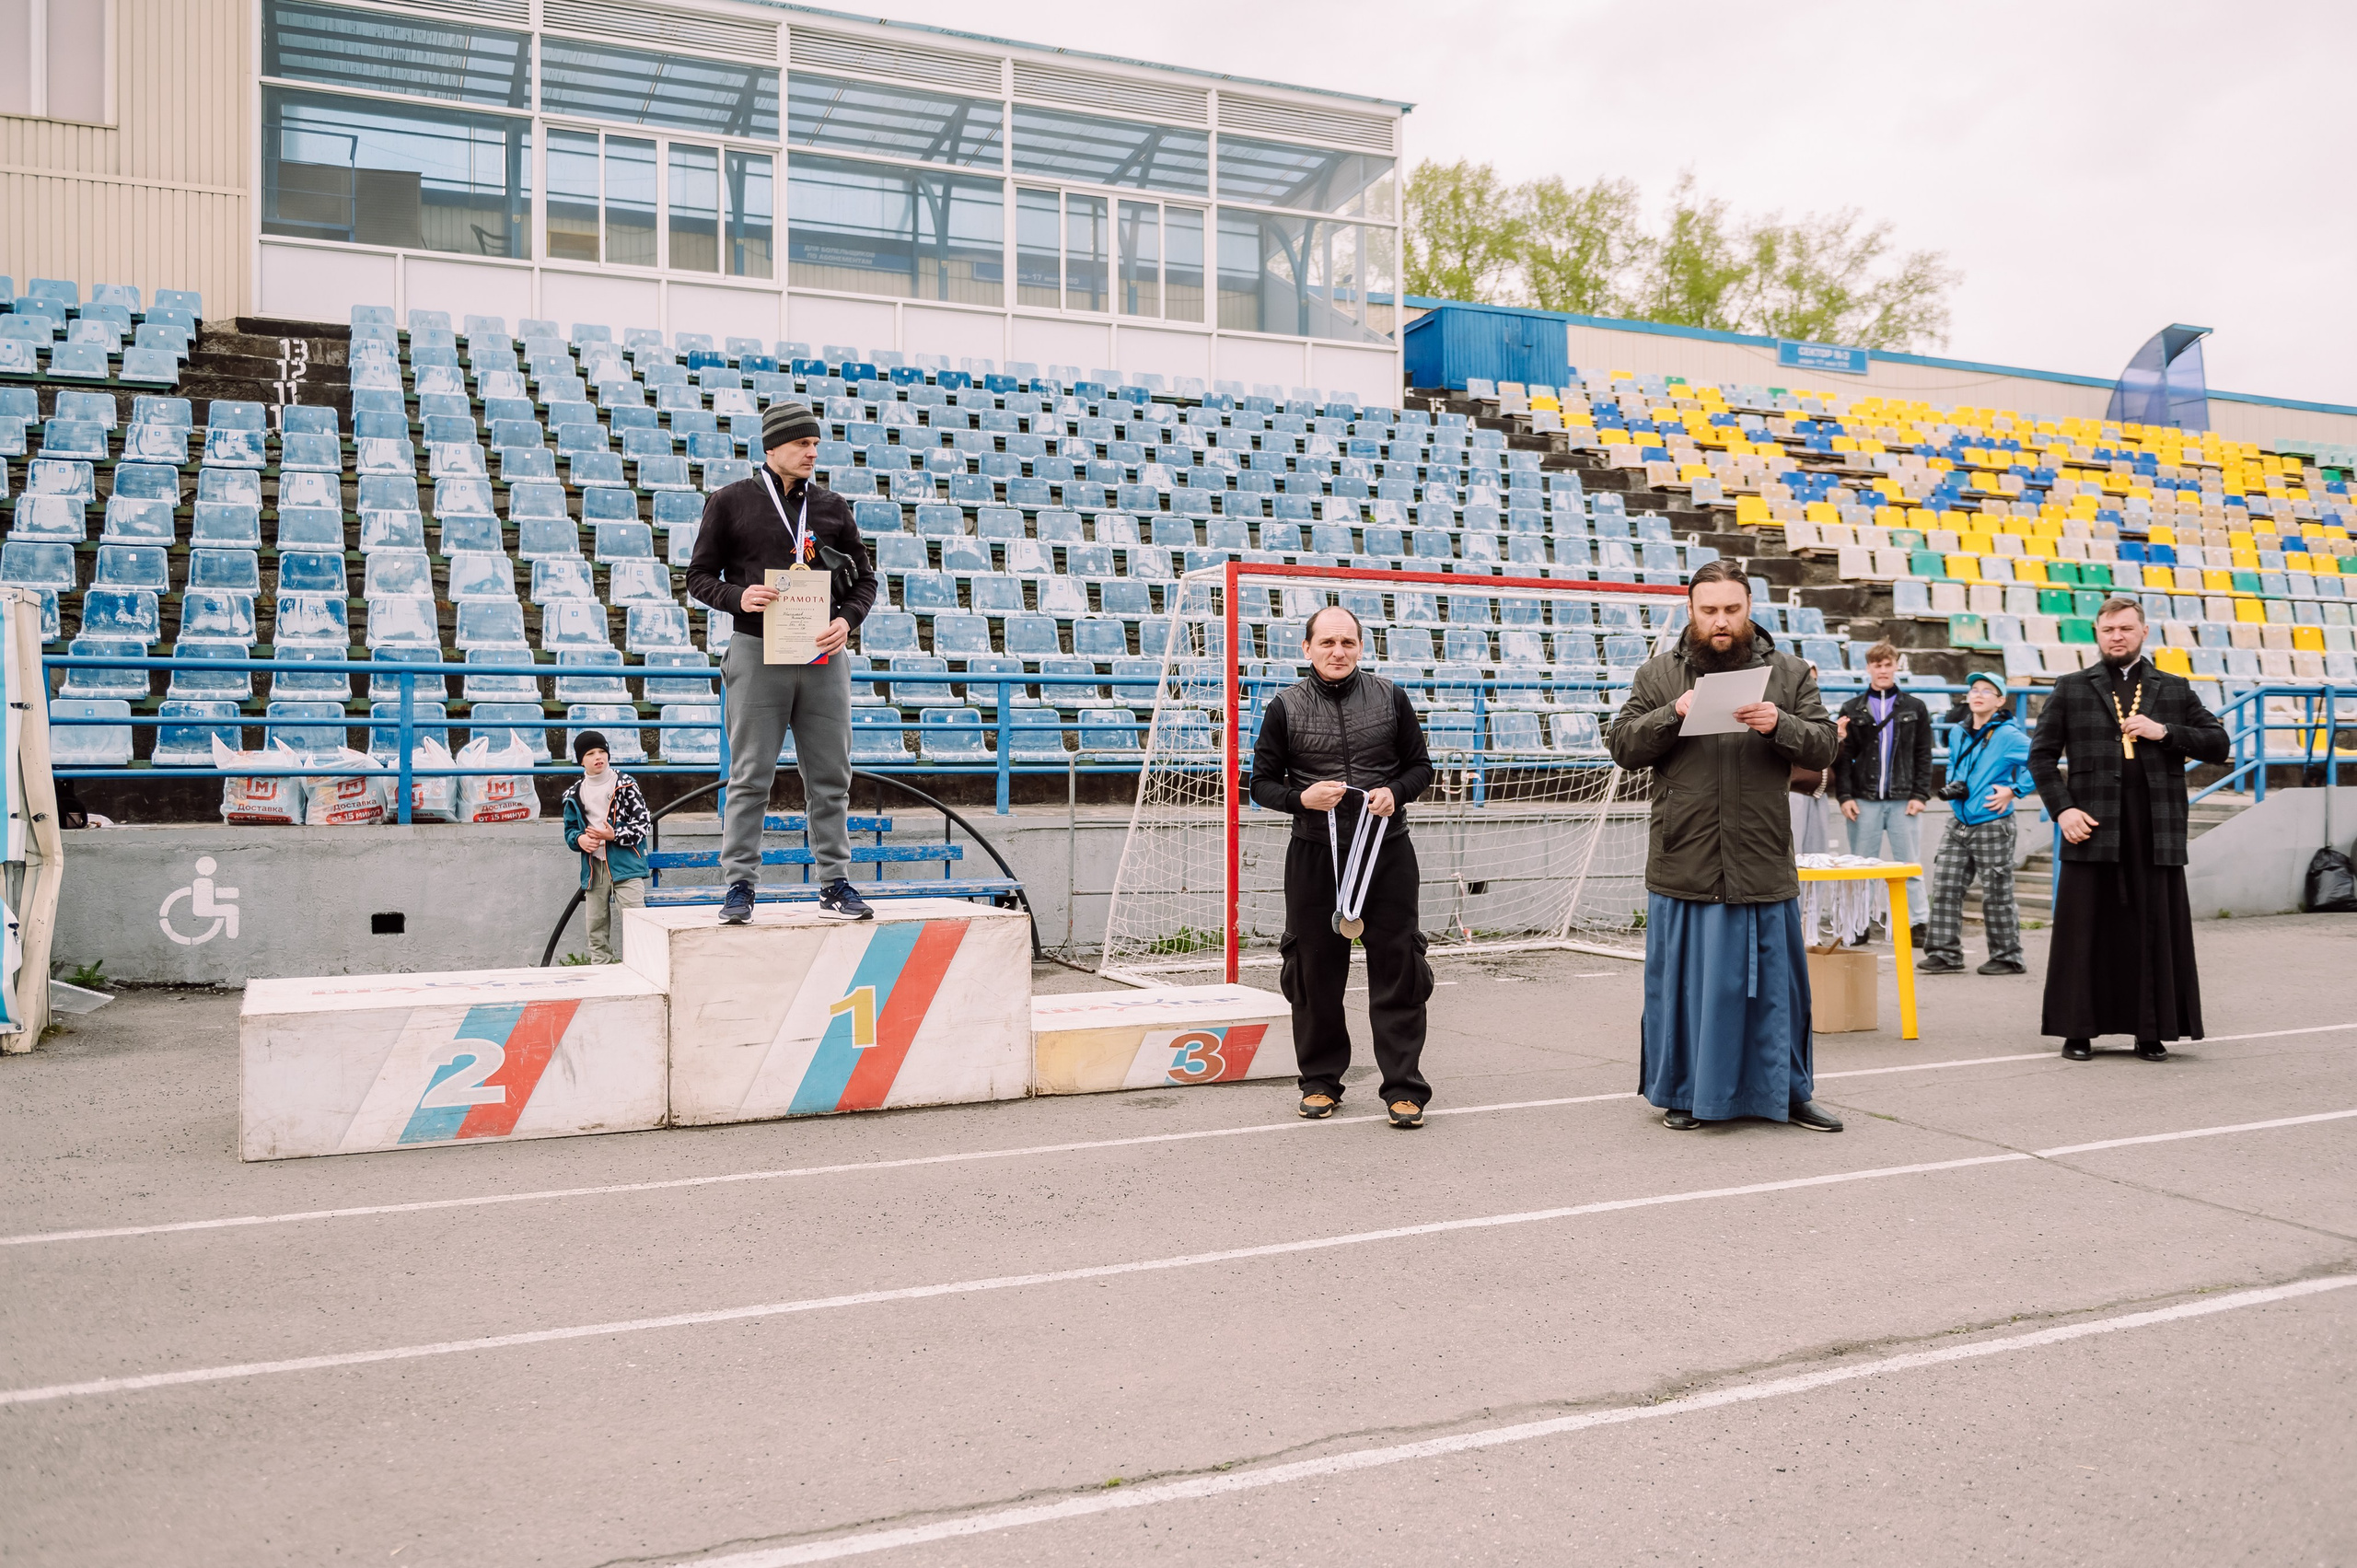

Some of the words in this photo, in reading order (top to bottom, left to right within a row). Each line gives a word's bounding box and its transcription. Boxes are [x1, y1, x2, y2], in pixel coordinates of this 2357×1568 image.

[819, 254, 873, 265] АБОНЕМЕНТАМ
[279, 338, 308, 361] 13
[277, 359, 307, 382] 12
[273, 381, 297, 405] 11
[1428, 398, 1447, 414] 15
[1788, 587, 1801, 609] 6
[237, 803, 283, 813] Доставка
[333, 799, 377, 812] Доставка
[356, 809, 380, 819] минут
[501, 810, 526, 820] минут
[829, 985, 877, 1049] 1
[1167, 1030, 1226, 1084] 3
[420, 1038, 506, 1109] 2
